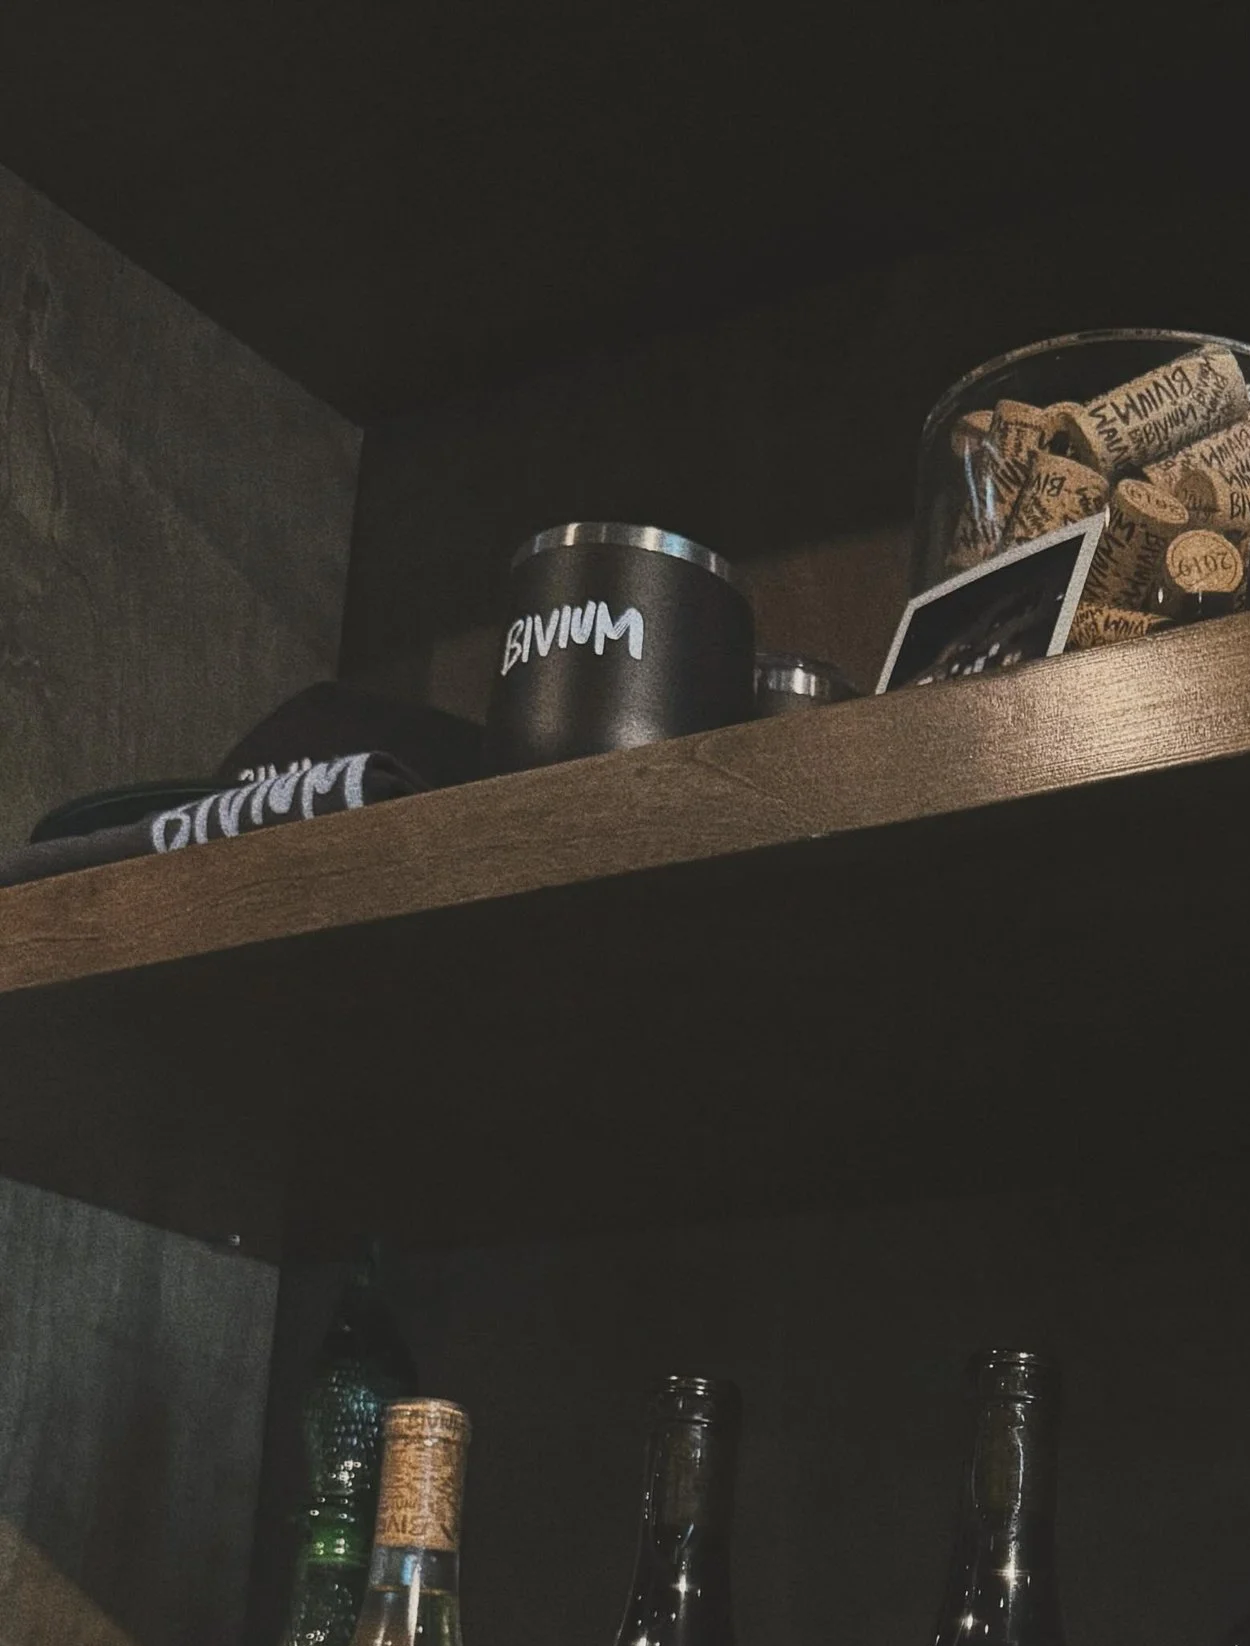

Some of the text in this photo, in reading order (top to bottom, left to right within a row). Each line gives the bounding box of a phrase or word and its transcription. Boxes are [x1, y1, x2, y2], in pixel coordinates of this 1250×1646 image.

[1110, 365, 1194, 426] BIVIUM
[1173, 552, 1233, 580] 2019
[500, 600, 645, 677] BIVIUM
